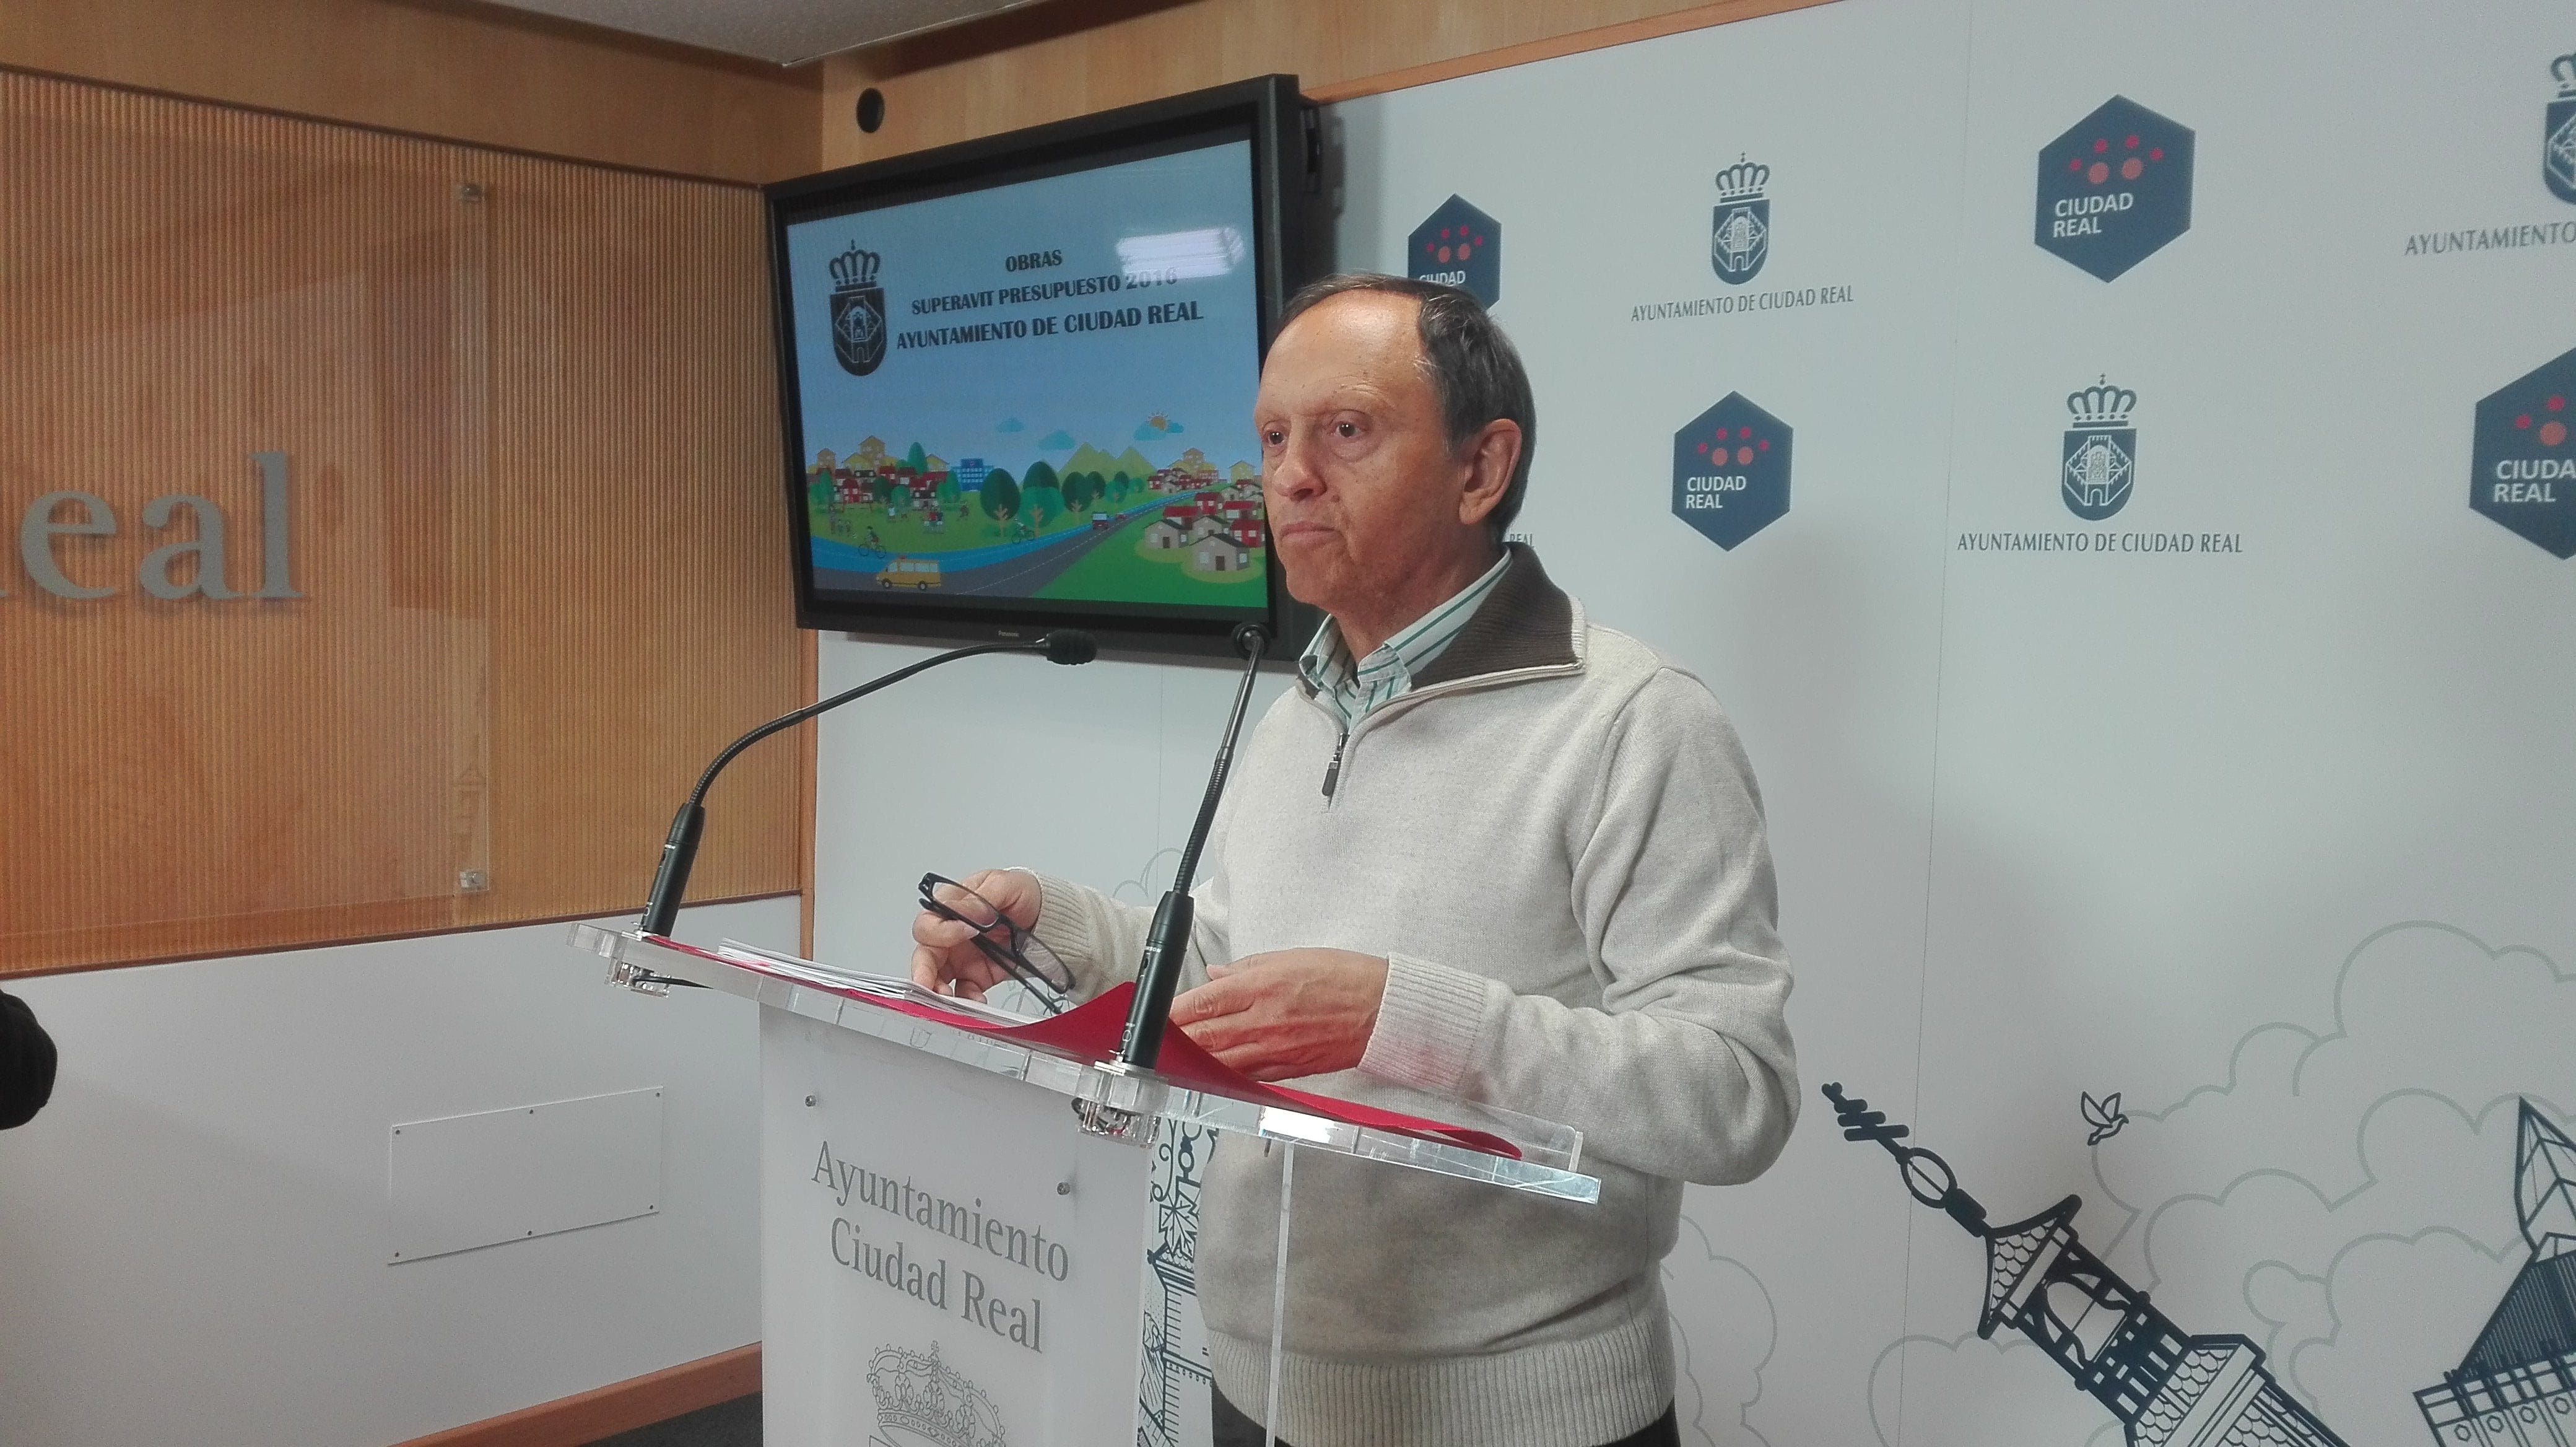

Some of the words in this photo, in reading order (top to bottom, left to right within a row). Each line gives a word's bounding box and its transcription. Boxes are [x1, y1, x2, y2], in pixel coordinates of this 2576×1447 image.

[2055, 193, 2134, 217] CIUDAD
[2053, 216, 2102, 237] REAL
[2403, 221, 2576, 256] AYUNTAMIENTO
[1006, 250, 1063, 272] OBRAS
[912, 290, 994, 315] SUPERAVIT
[998, 274, 1121, 305] PRESUPUESTO
[1631, 296, 1733, 321] AYUNTAMIENTO
[1738, 294, 1756, 312] DE
[1759, 289, 1816, 310] CIUDAD
[1821, 285, 1854, 305] REAL
[897, 320, 1027, 349] AYUNTAMIENTO
[1032, 316, 1058, 336] DE
[1064, 307, 1142, 333] CIUDAD
[1147, 300, 1204, 325] REAL
[2497, 459, 2576, 480] CIUDA
[1687, 476, 1747, 492] CIUDAD
[2493, 483, 2557, 503] REAL
[1686, 494, 1723, 509] REAL
[0, 450, 303, 600] eal
[1957, 533, 2089, 552] AYUNTAMIENTO
[2095, 533, 2116, 552] DE
[2121, 533, 2194, 553] CIUDAD
[2201, 533, 2243, 553] REAL
[811, 1140, 1069, 1282] Ayuntamiento
[830, 1217, 948, 1310] Ciudad
[961, 1269, 1042, 1354] Real
